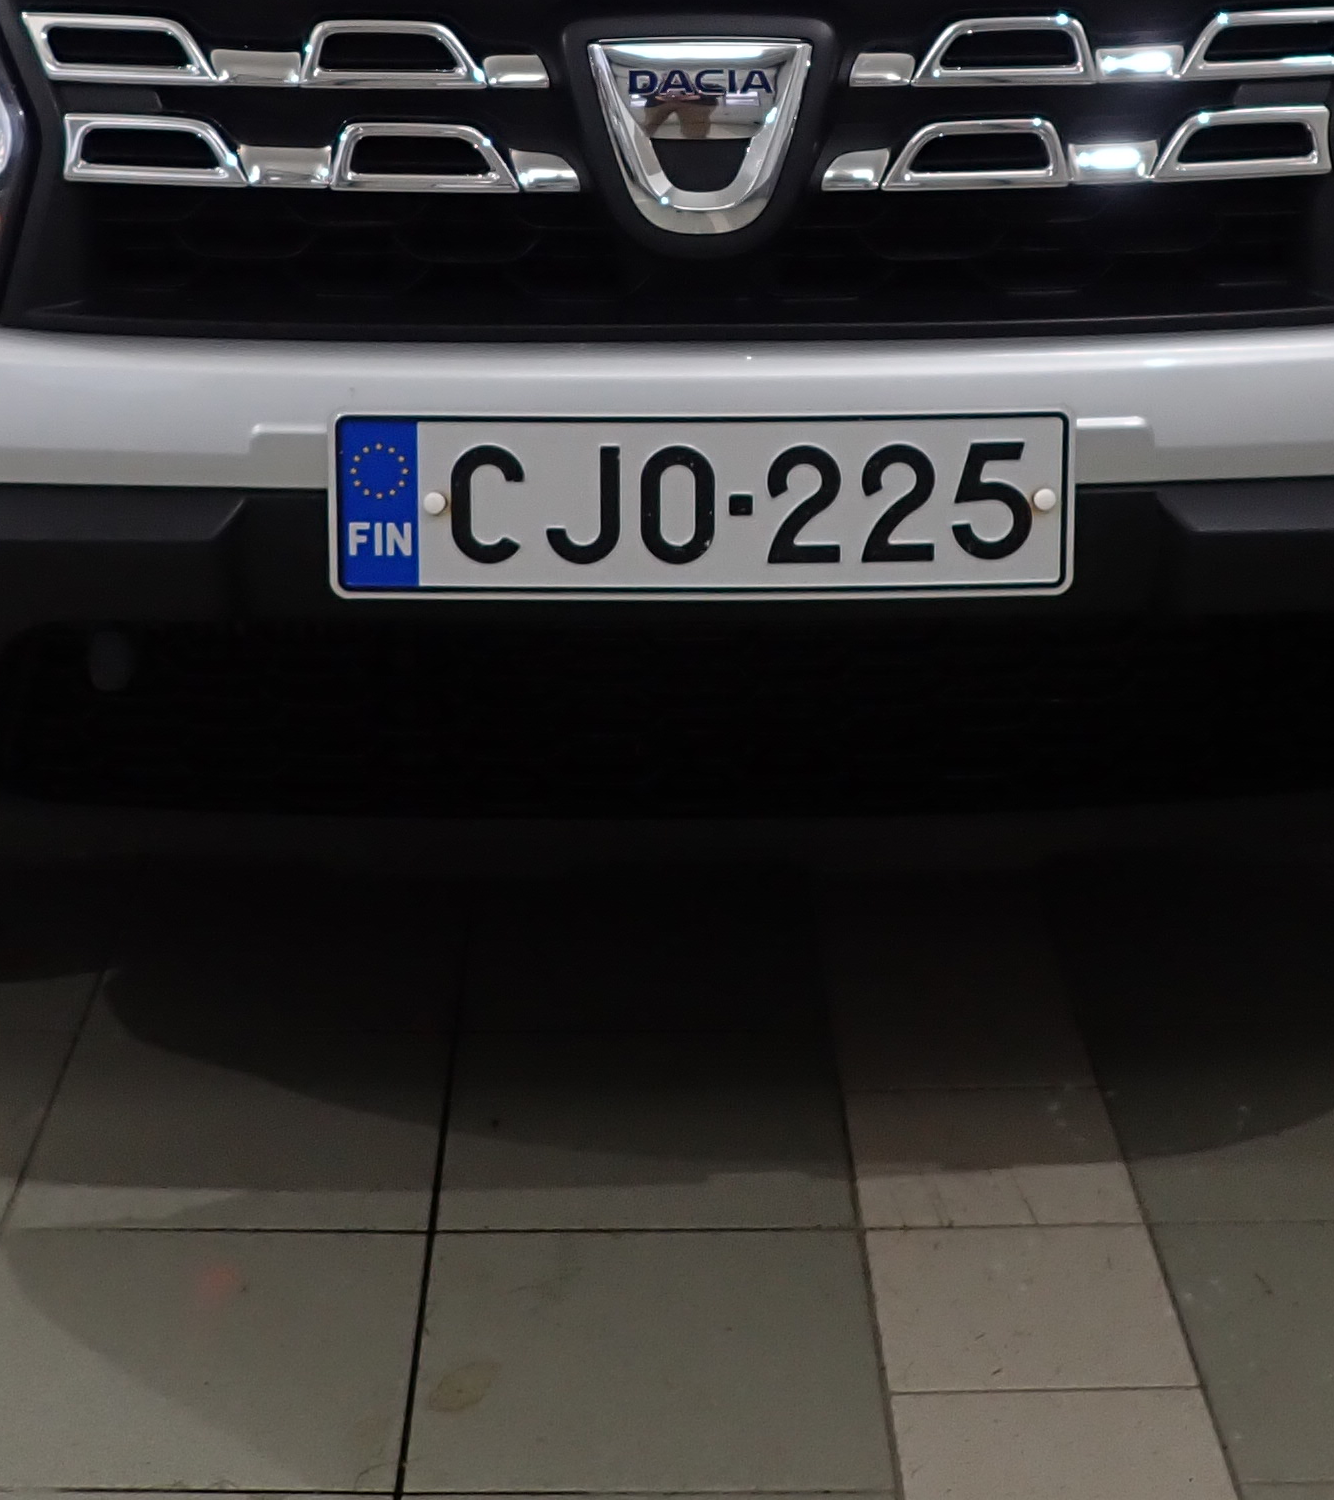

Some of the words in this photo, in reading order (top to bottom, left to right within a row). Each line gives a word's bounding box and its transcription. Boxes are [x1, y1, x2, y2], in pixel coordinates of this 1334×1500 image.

[627, 68, 774, 96] DACIA
[450, 440, 1034, 565] CJO-225
[348, 521, 413, 557] FIN
